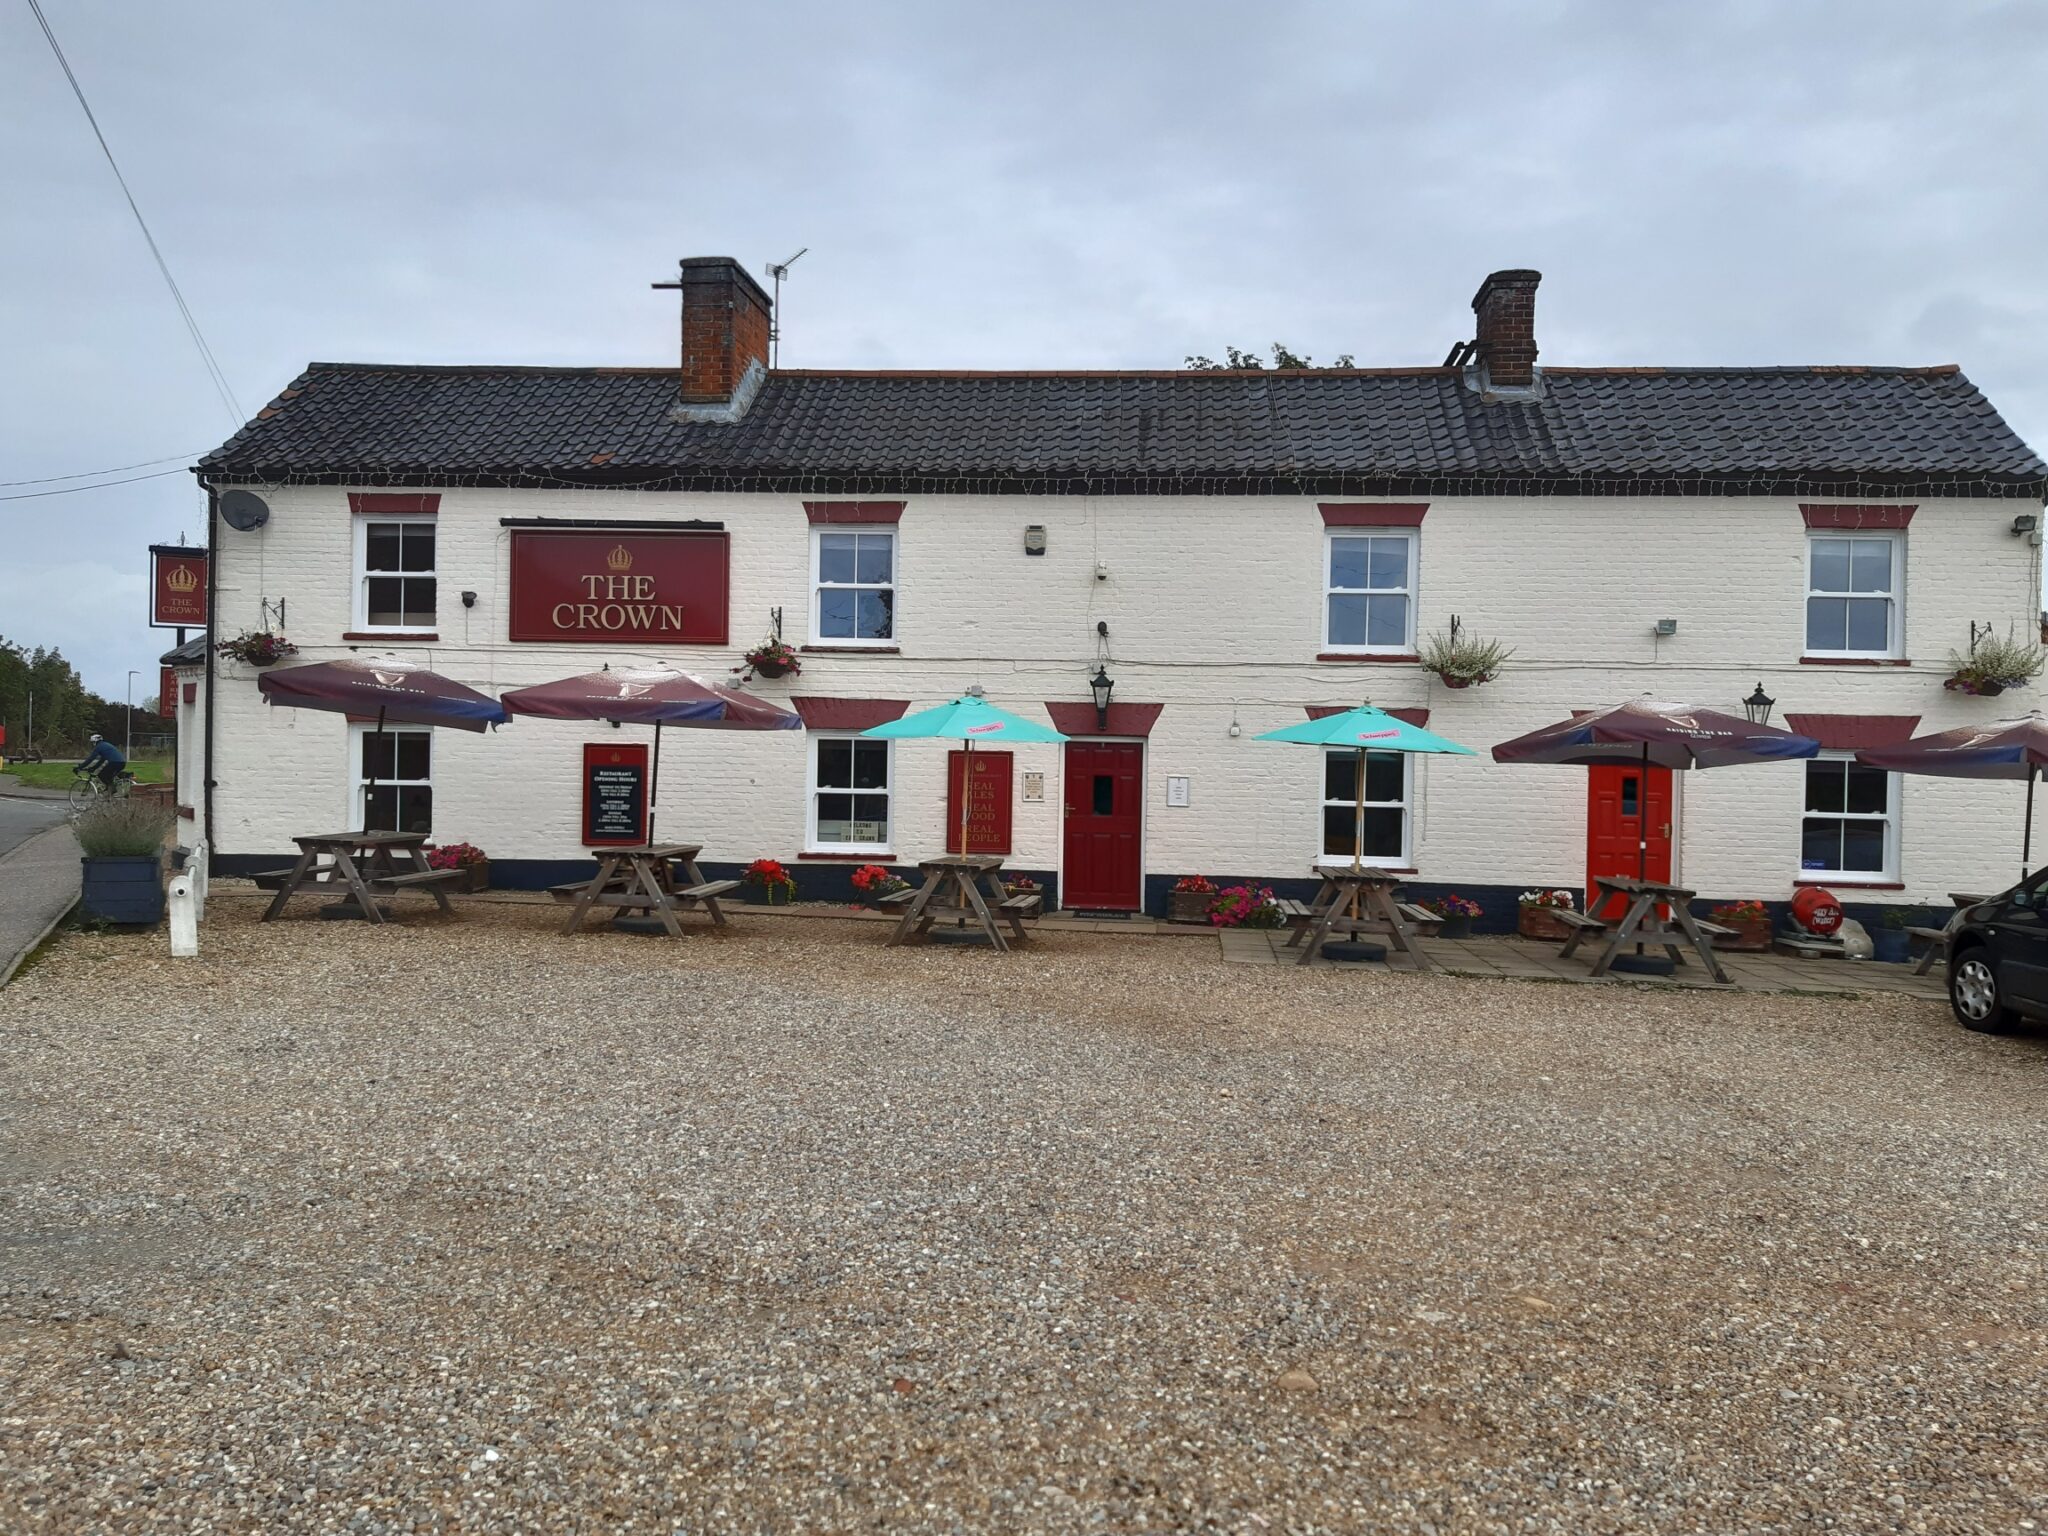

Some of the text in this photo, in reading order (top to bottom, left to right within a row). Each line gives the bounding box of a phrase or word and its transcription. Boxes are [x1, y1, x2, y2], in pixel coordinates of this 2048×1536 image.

[581, 574, 656, 601] THE
[161, 605, 200, 615] CROWN
[171, 598, 193, 606] THE
[552, 603, 684, 631] CROWN
